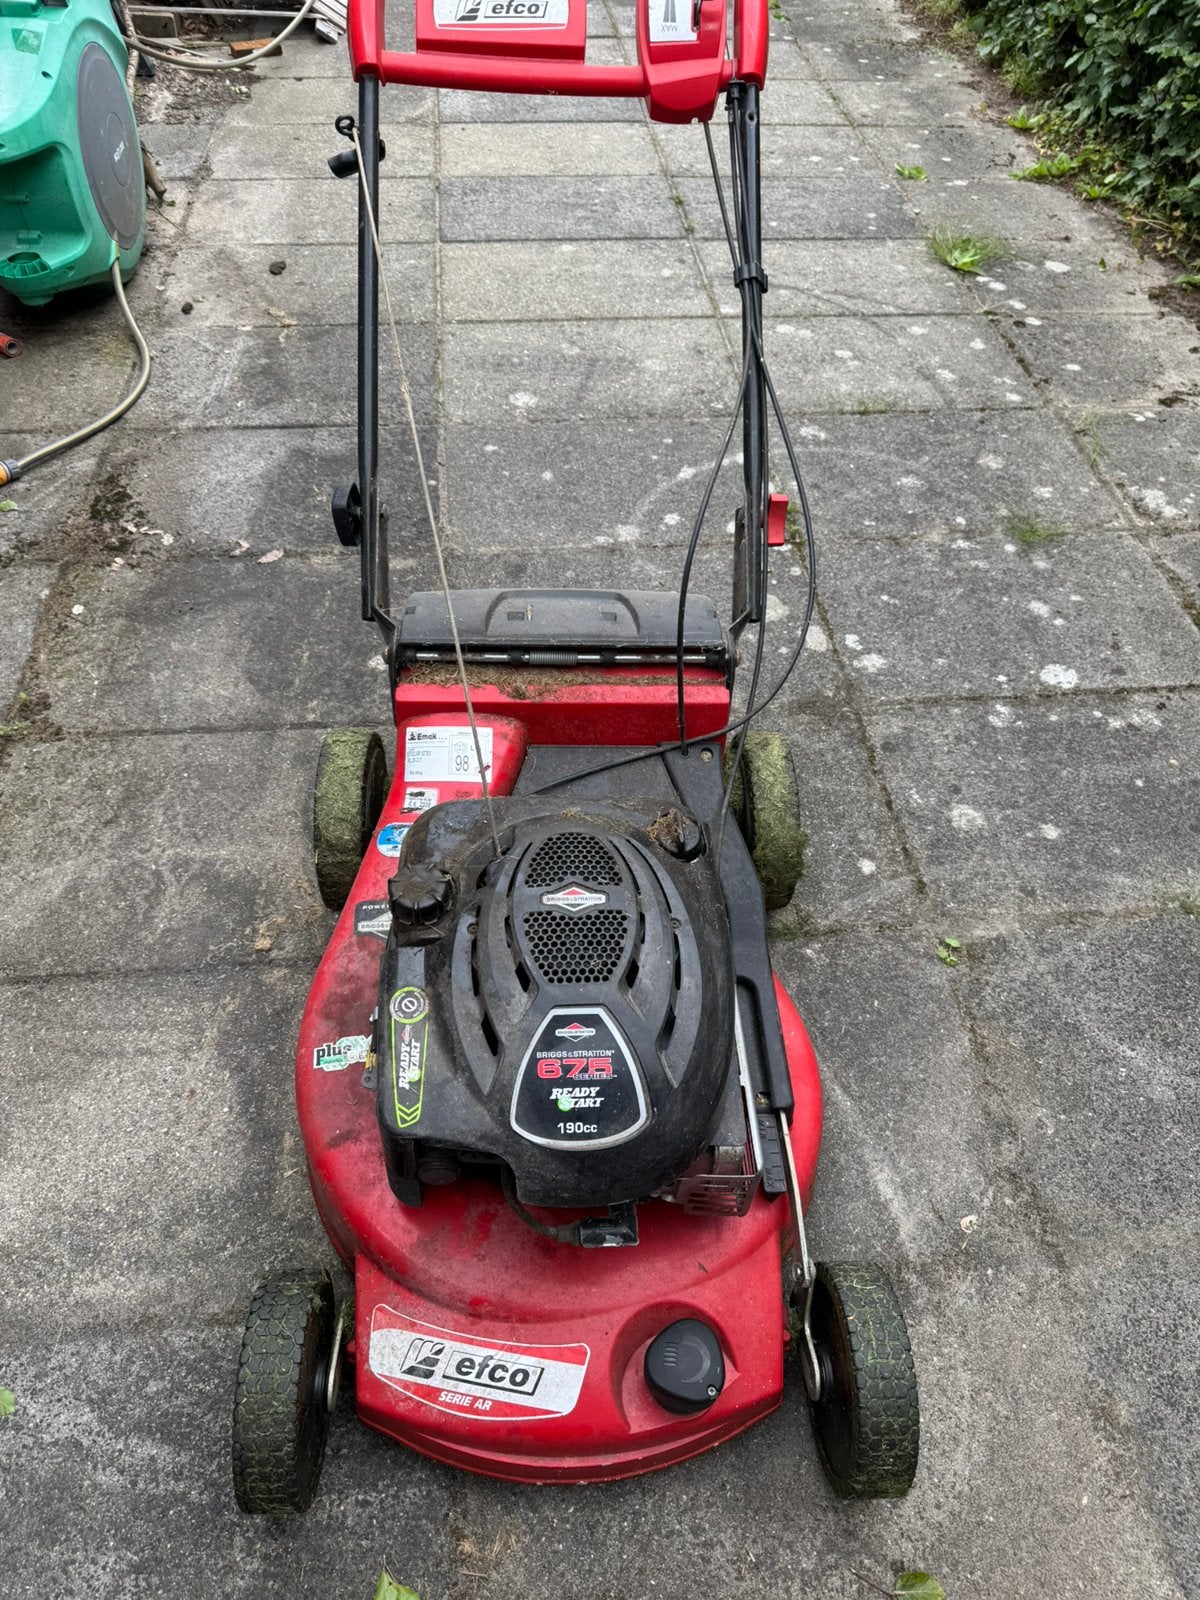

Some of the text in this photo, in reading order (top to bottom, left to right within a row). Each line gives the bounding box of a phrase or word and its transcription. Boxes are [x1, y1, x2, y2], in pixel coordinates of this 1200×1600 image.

[491, 0, 541, 15] efco
[661, 24, 678, 32] MAX
[455, 754, 470, 772] 98
[537, 1057, 613, 1079] 675
[573, 1072, 613, 1080] SERIES
[549, 1086, 601, 1100] READY
[557, 1122, 598, 1134] 190cc
[455, 1354, 530, 1388] efco
[438, 1391, 493, 1411] SERIE AR
